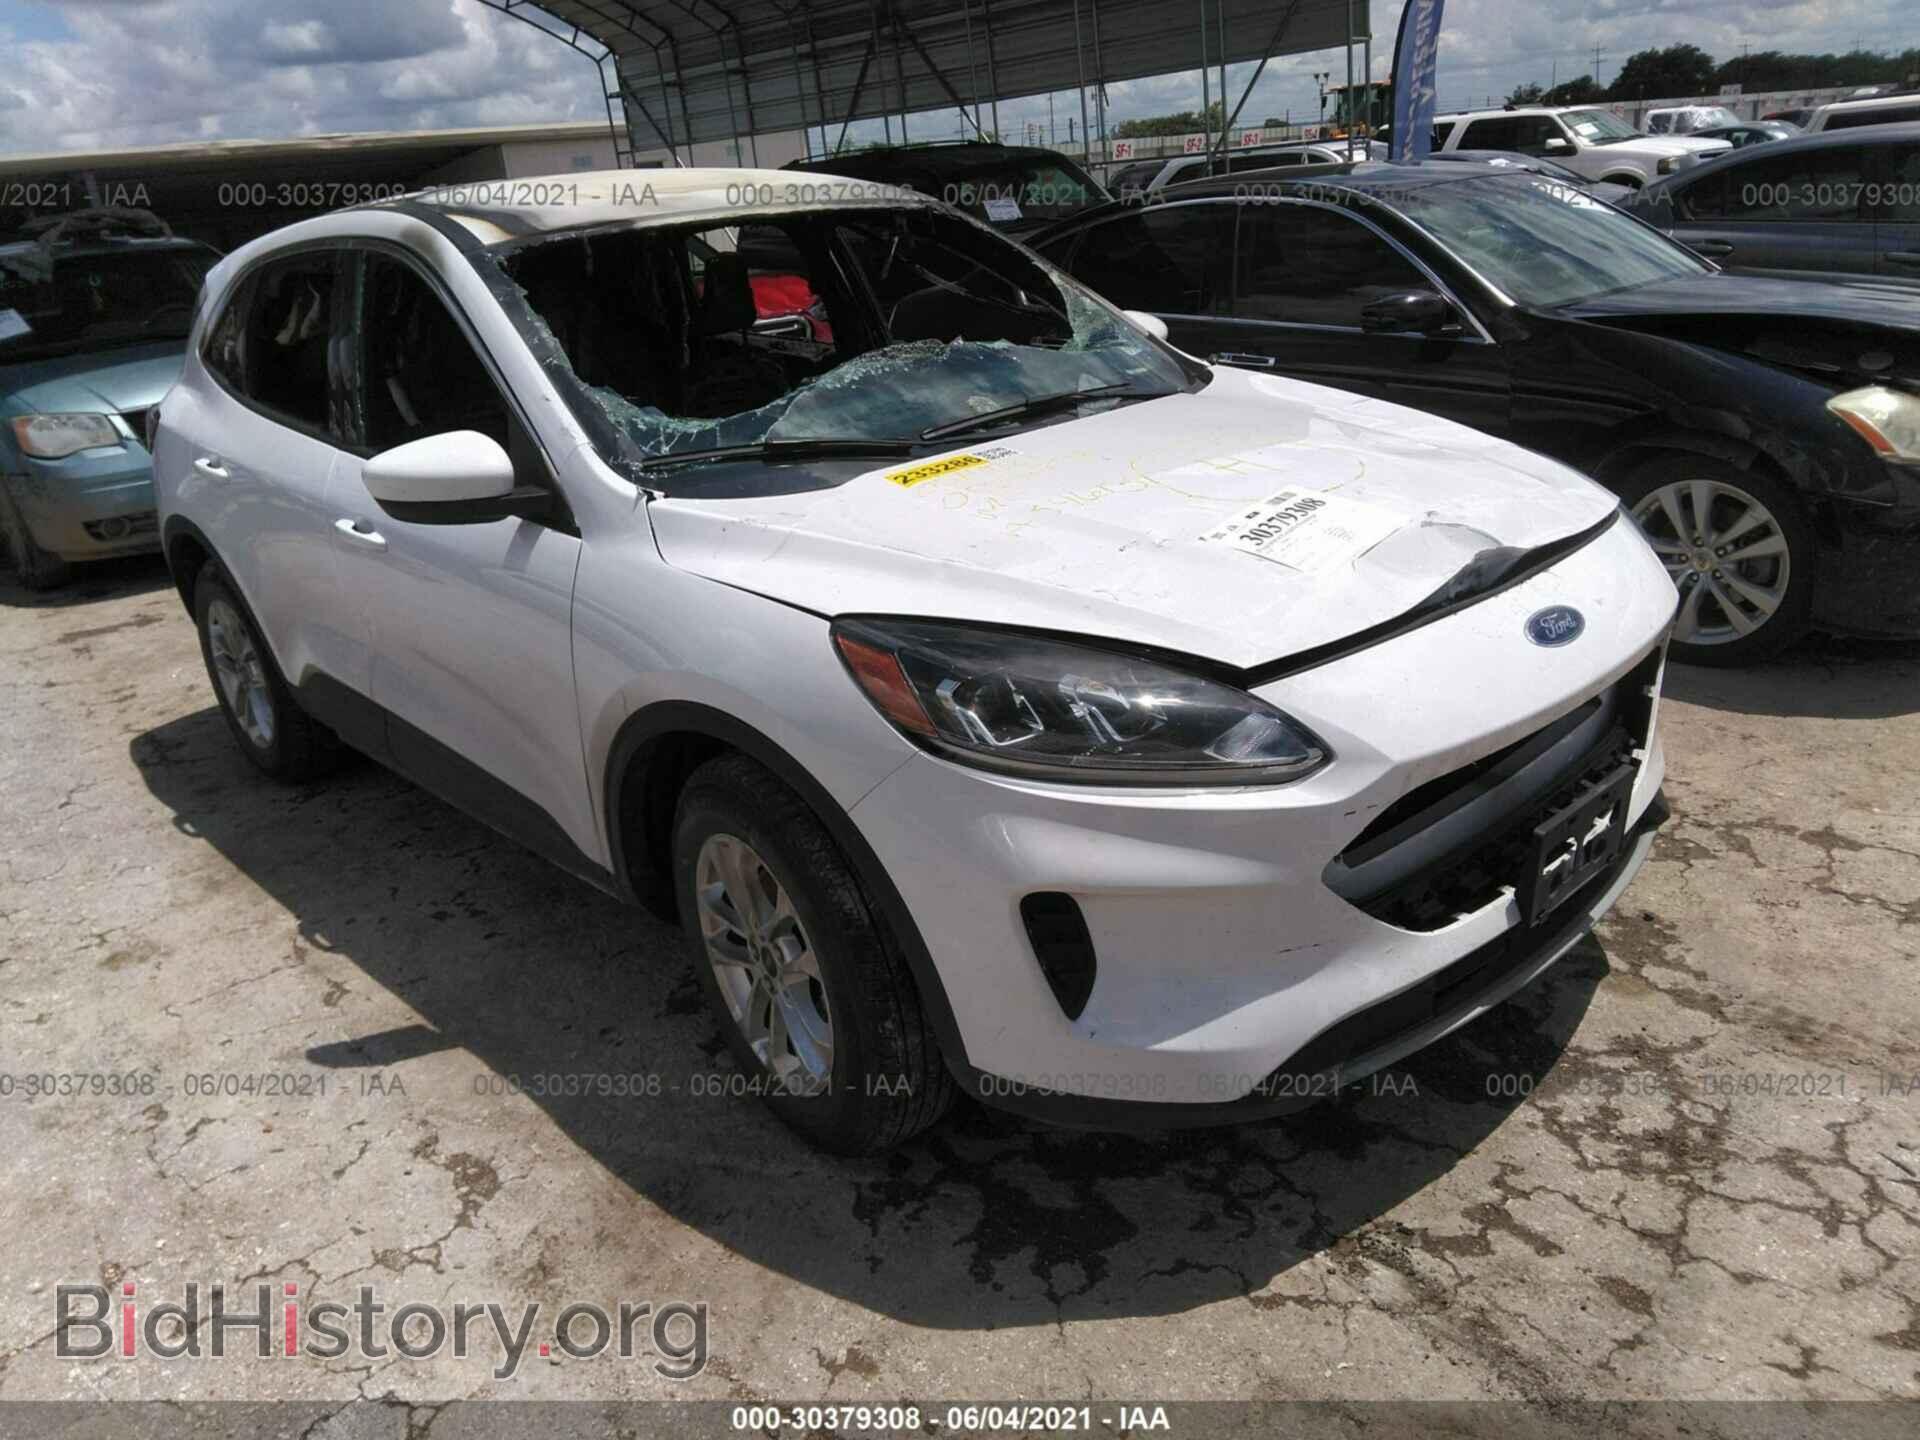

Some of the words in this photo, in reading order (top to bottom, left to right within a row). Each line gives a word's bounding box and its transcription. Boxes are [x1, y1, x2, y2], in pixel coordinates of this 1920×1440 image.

[1115, 143, 1131, 158] SF-1
[1239, 498, 1326, 546] 30379308
[1541, 613, 1576, 638] Ford
